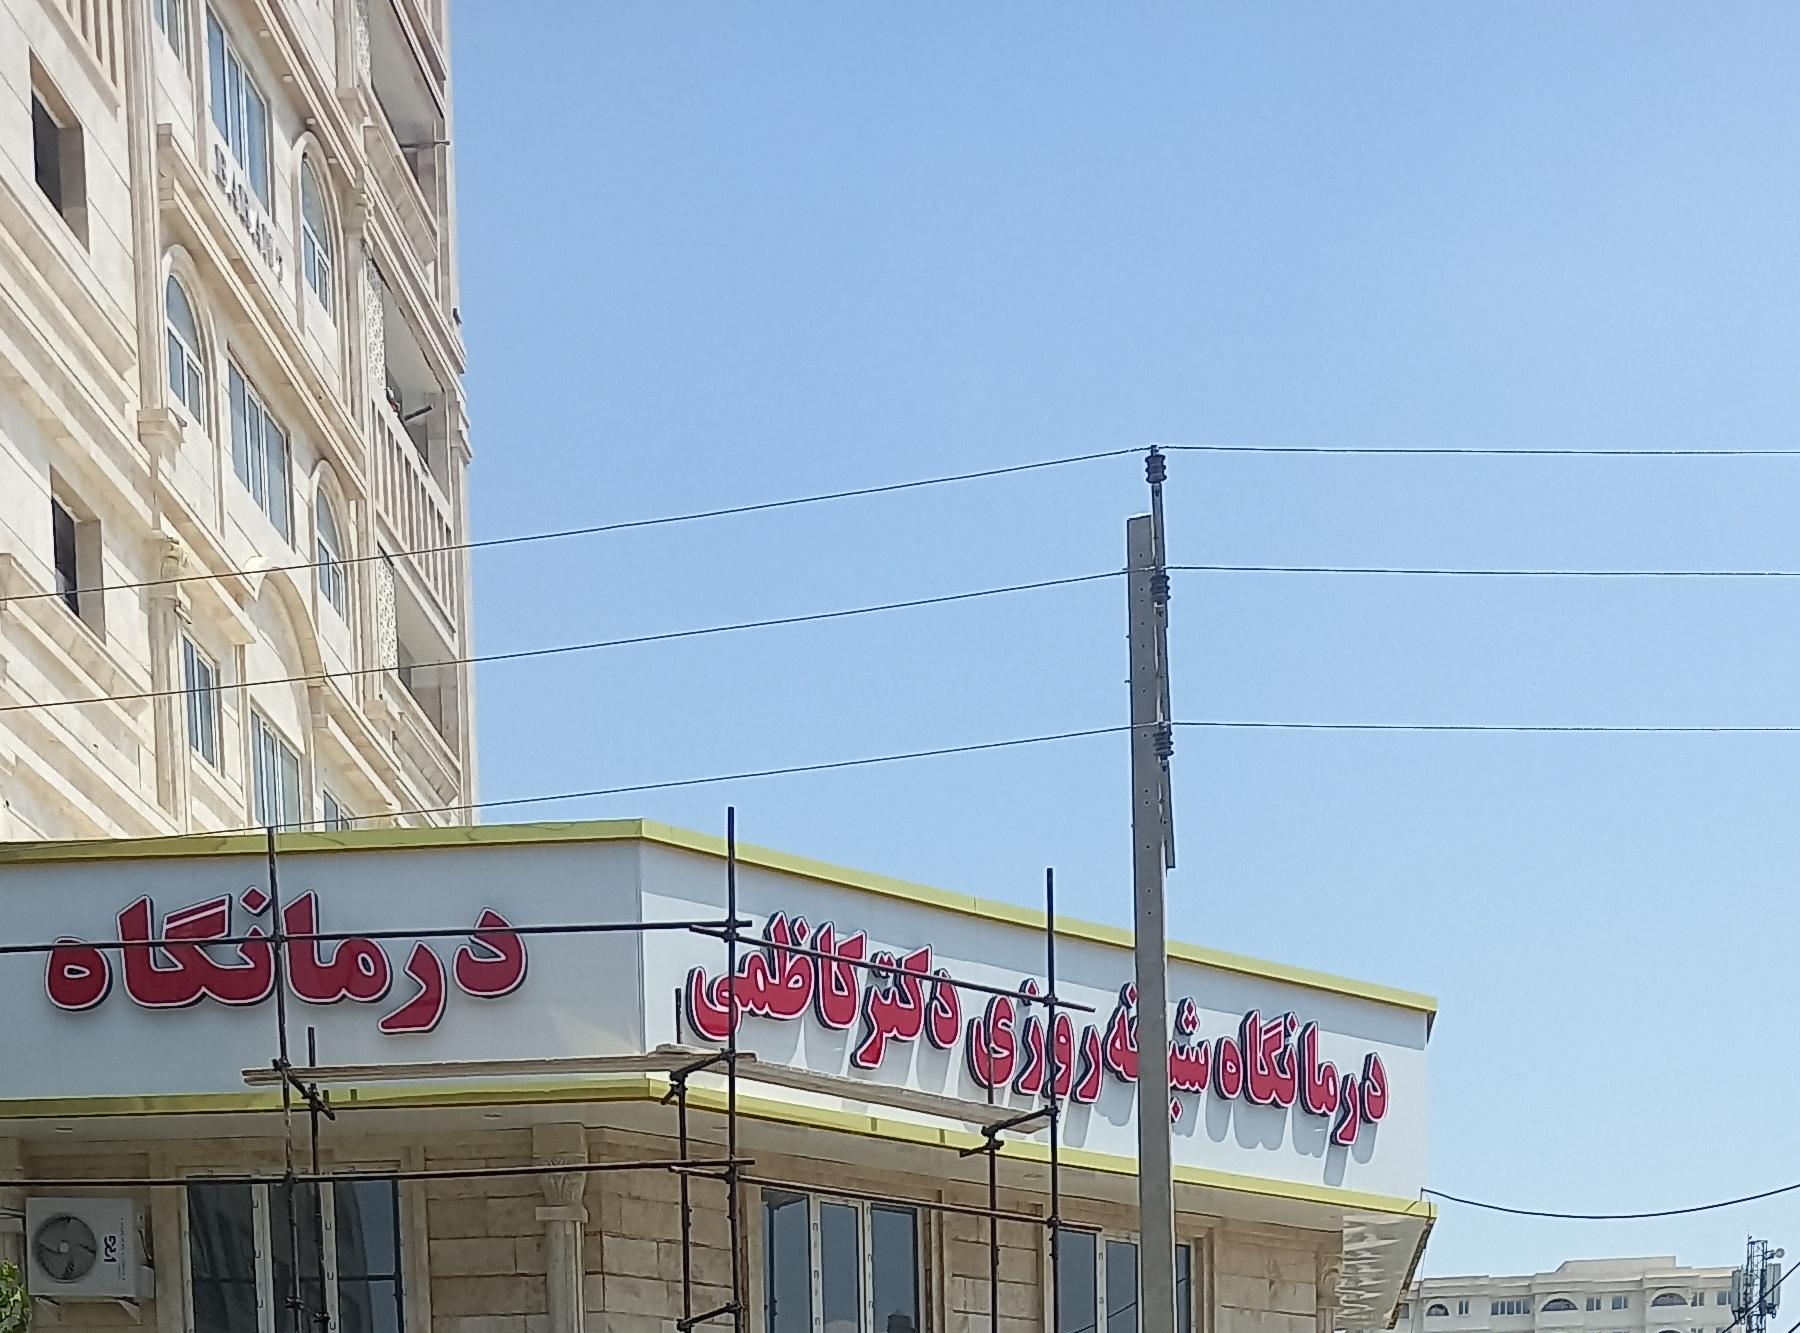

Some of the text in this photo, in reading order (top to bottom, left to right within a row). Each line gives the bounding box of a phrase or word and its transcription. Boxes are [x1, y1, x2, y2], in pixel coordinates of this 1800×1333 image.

[43, 884, 529, 1035] درمانگاه
[1103, 982, 1212, 1124] شبنه
[1213, 1009, 1390, 1147] درمانگاه
